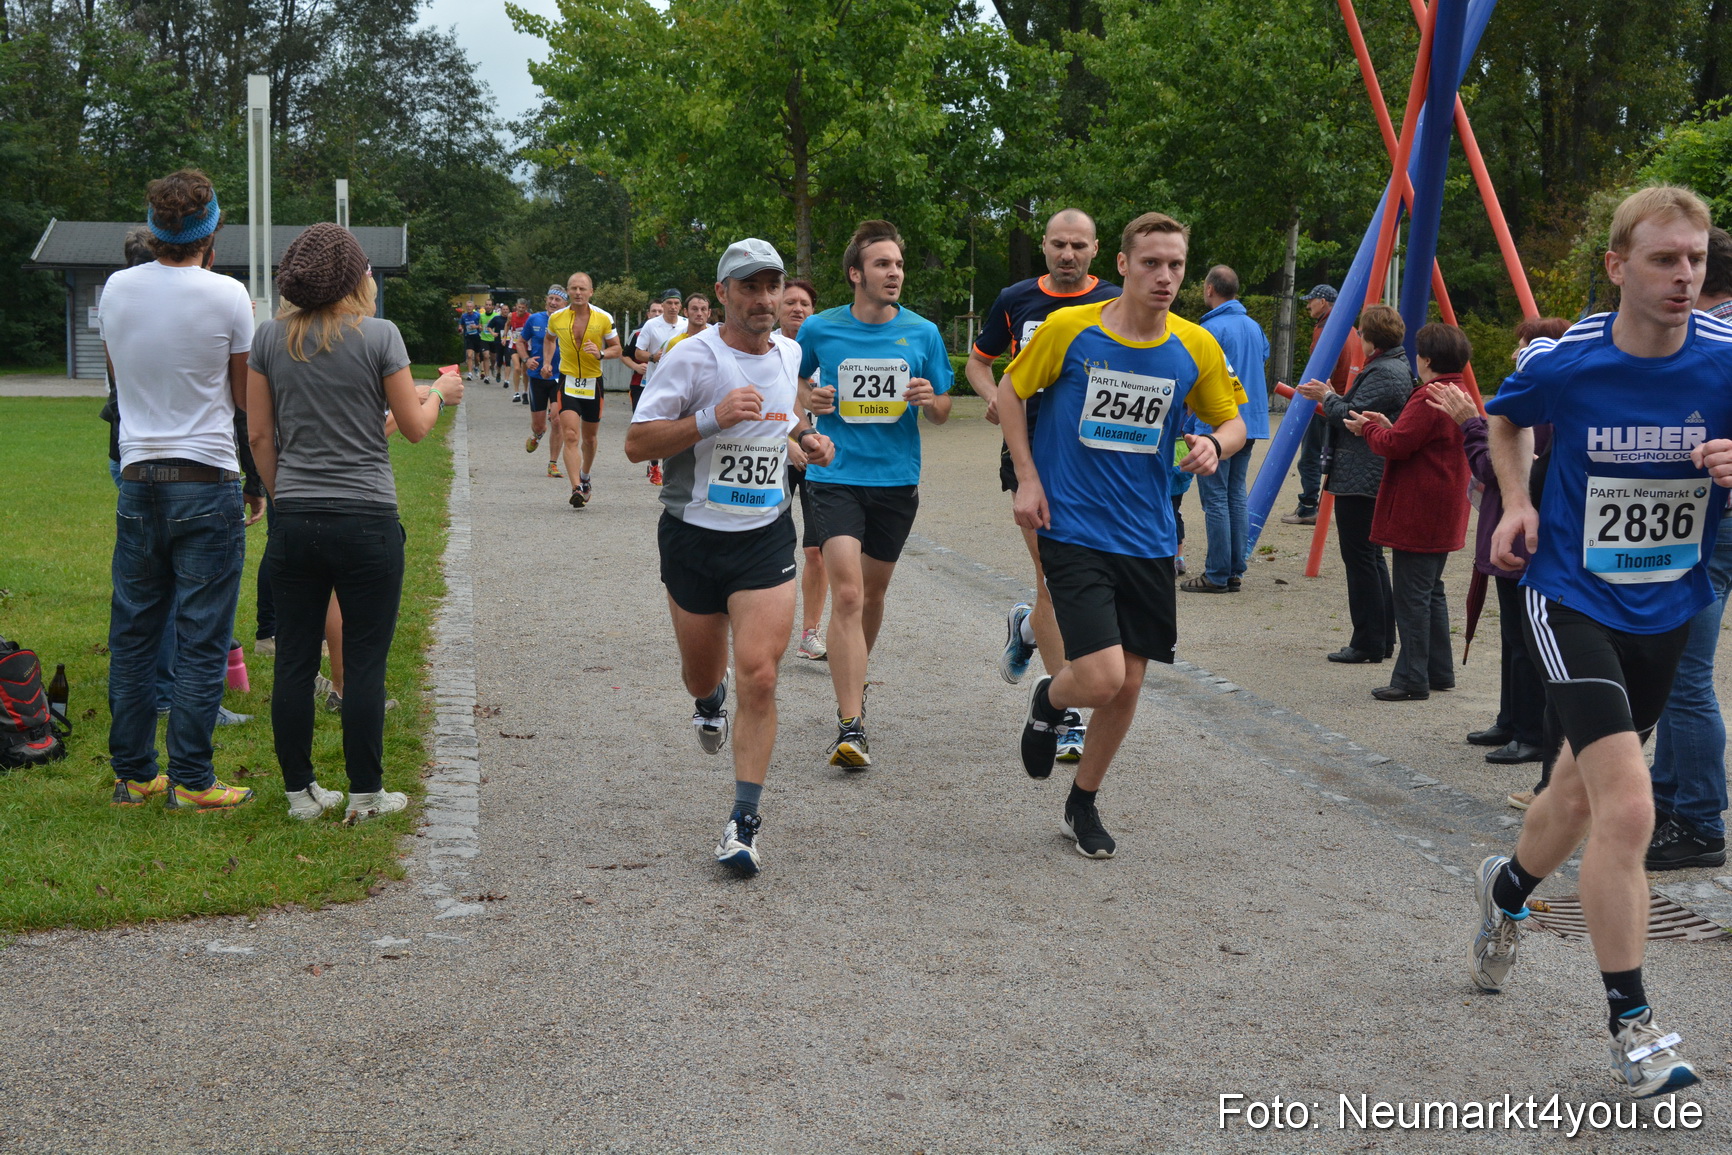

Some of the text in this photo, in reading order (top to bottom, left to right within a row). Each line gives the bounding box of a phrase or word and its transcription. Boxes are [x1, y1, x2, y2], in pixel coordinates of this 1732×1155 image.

[574, 377, 587, 388] 84
[853, 374, 896, 398] 234
[1091, 376, 1160, 394] PARTL Neumarkt
[858, 404, 889, 414] Tobias
[1092, 390, 1163, 425] 2546
[760, 412, 789, 422] EBL
[1094, 425, 1147, 442] Alexander
[1587, 426, 1707, 450] HUBER
[715, 443, 779, 453] PARTL Neumarkt
[1613, 452, 1691, 462] TECHNOLOG
[718, 455, 779, 485] 2352
[731, 491, 766, 504] Roland
[1590, 488, 1689, 498] PARTL Neumarkt
[1597, 502, 1696, 543] 2836
[1615, 553, 1672, 568] Thomas
